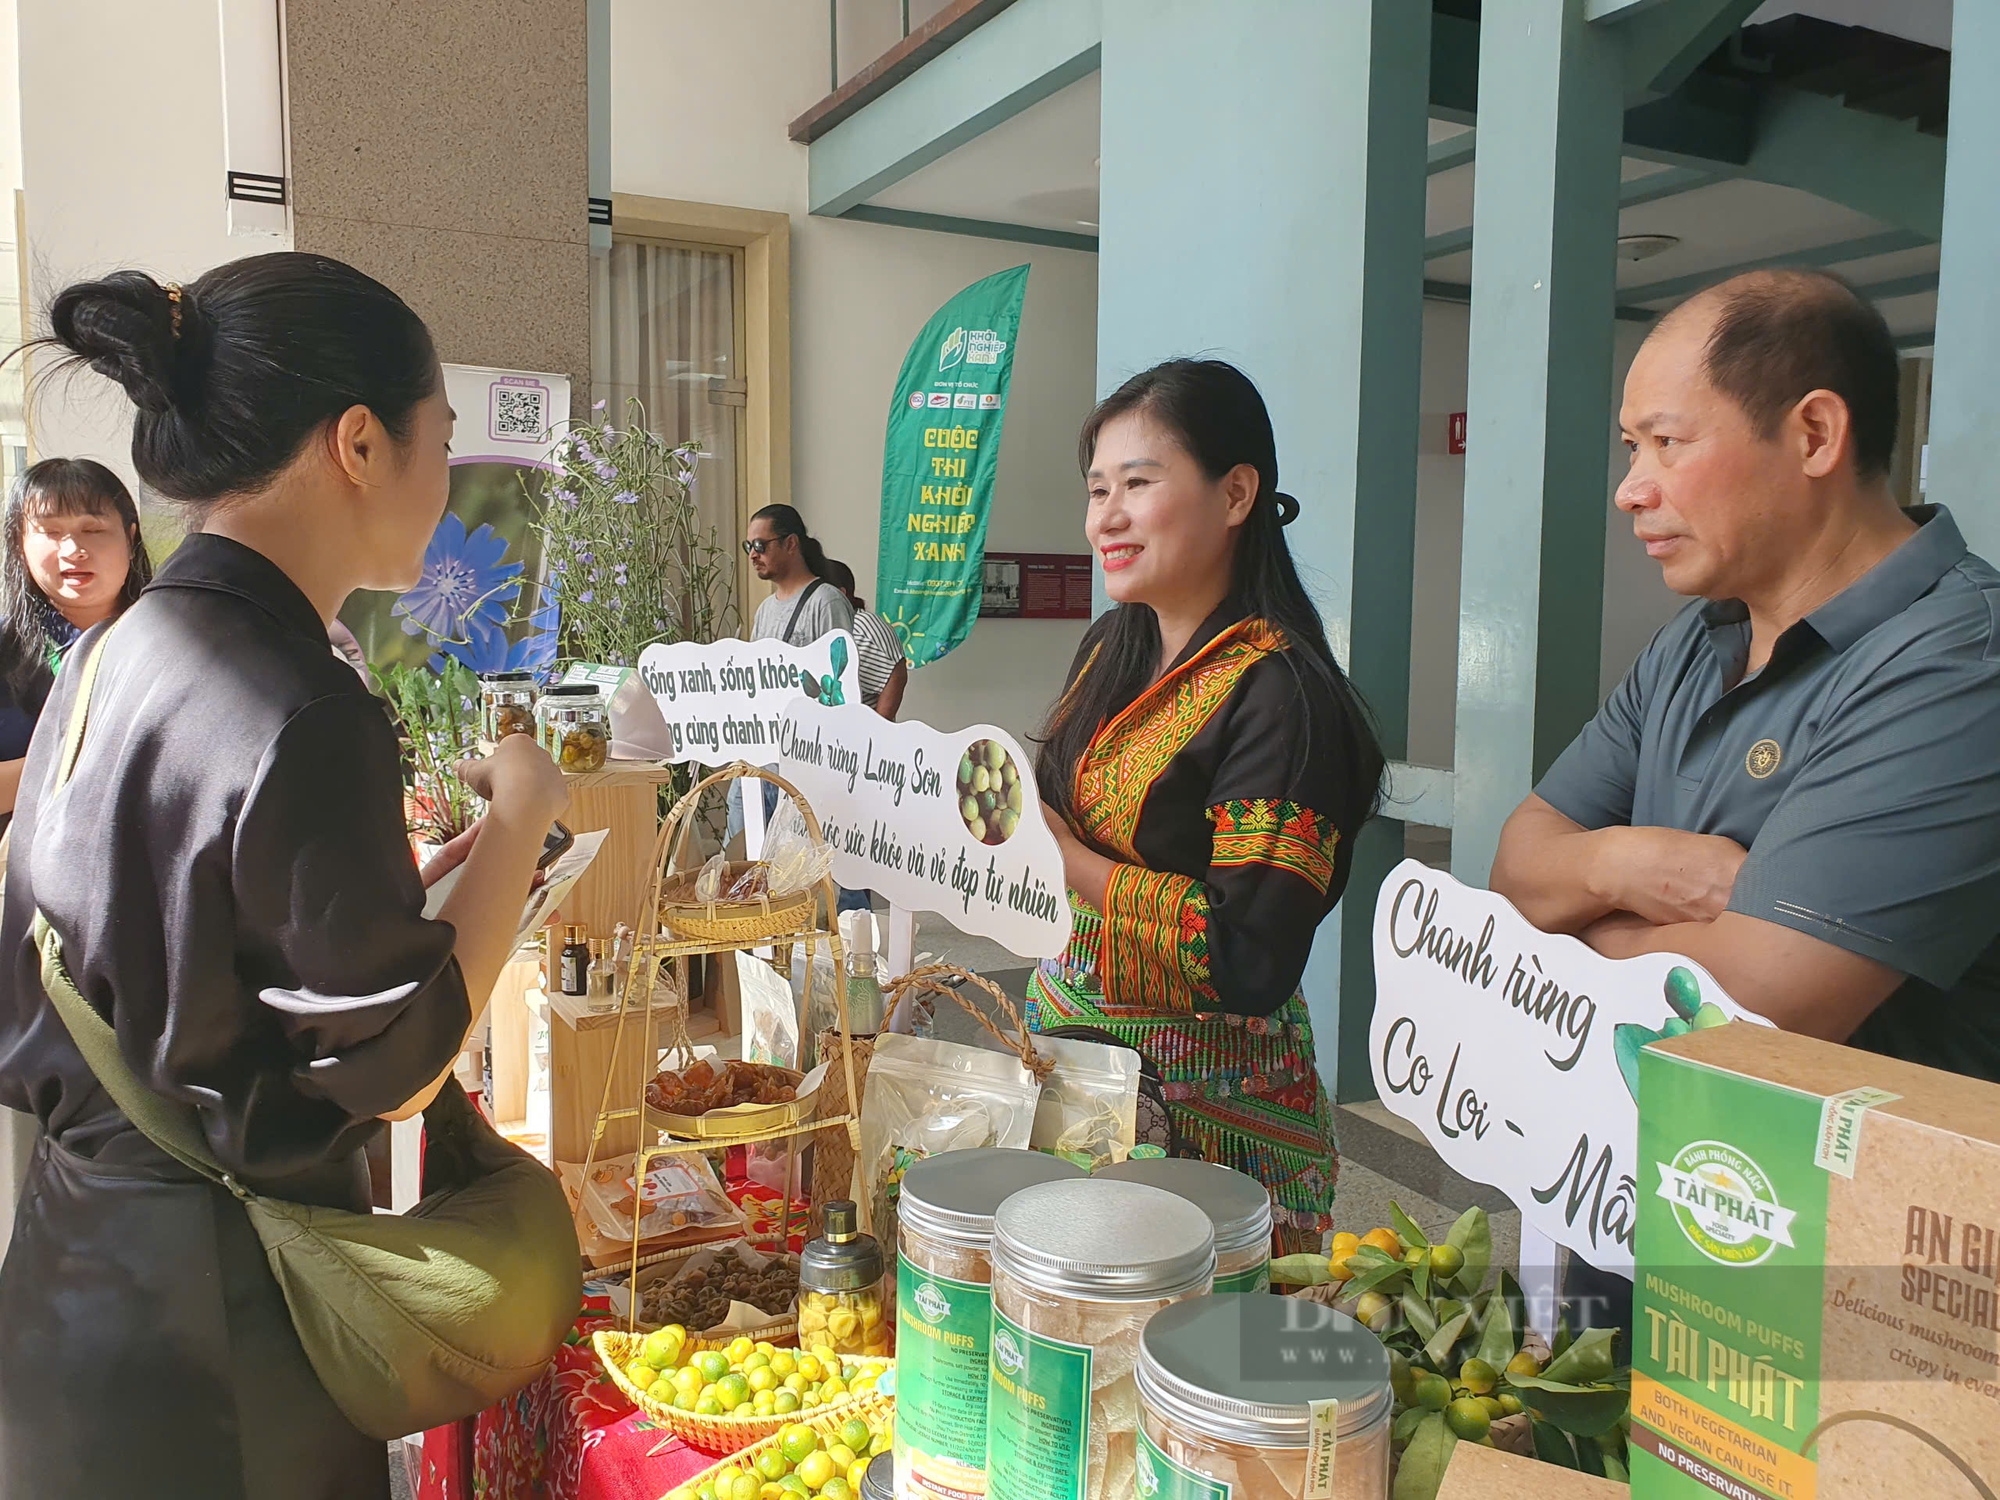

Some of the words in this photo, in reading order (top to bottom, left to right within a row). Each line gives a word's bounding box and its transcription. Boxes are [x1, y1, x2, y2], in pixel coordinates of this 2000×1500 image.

[525, 379, 536, 387] ME
[924, 425, 978, 453] CUỘC
[931, 457, 966, 478] THI
[920, 481, 973, 506] KHỞI
[907, 511, 976, 538] NGHIỆP
[913, 541, 966, 562] XANH
[641, 661, 676, 702] Sống
[680, 662, 717, 695] xanh,
[720, 655, 756, 699] sống
[757, 654, 800, 690] khỏe
[686, 714, 719, 754] cùng
[722, 713, 765, 745] chanh
[780, 717, 824, 767] Chanh
[827, 737, 860, 795] rừng
[864, 737, 907, 807] Lạng
[911, 747, 943, 798] Sơn
[844, 820, 867, 858] sức
[870, 818, 903, 870] khỏe
[907, 843, 926, 878] và
[930, 847, 947, 886] vẻ
[951, 845, 979, 915] đẹp
[985, 854, 1004, 912] tự
[1008, 865, 1059, 924] nhiên
[1390, 877, 1499, 990] Chanh
[1502, 951, 1597, 1072] rừng
[1382, 1016, 1434, 1096] Co
[1436, 1041, 1491, 1142] Loi
[1834, 1116, 1853, 1163] PHÁT
[1674, 1177, 1707, 1208] TÀI
[1714, 1192, 1774, 1231] PHÁT
[1904, 1204, 1953, 1265] AN
[1961, 1222, 2000, 1287] GI
[902, 1307, 941, 1341] MUSHROOM
[944, 1331, 974, 1348] PUFFS
[1645, 1273, 1742, 1334] MUSHROOM
[1746, 1319, 1805, 1360] PUFFS
[1832, 1289, 1905, 1331] Delicious
[1644, 1305, 1700, 1382] TÀI
[1706, 1336, 1804, 1432] PHÁT
[1889, 1348, 1939, 1379] crispy
[1942, 1363, 1960, 1384] in
[1017, 1385, 1046, 1410] PUFFS
[1654, 1389, 1688, 1420] BOTH
[1692, 1406, 1777, 1466] VEGETARIAN
[1317, 1455, 1330, 1489] PHÁT
[1640, 1404, 1666, 1429] AND
[1669, 1423, 1712, 1455] VEGAN
[1715, 1447, 1744, 1473] CAN
[1747, 1462, 1775, 1488] USE
[1778, 1478, 1794, 1498] IT.
[1658, 1442, 1676, 1462] NO
